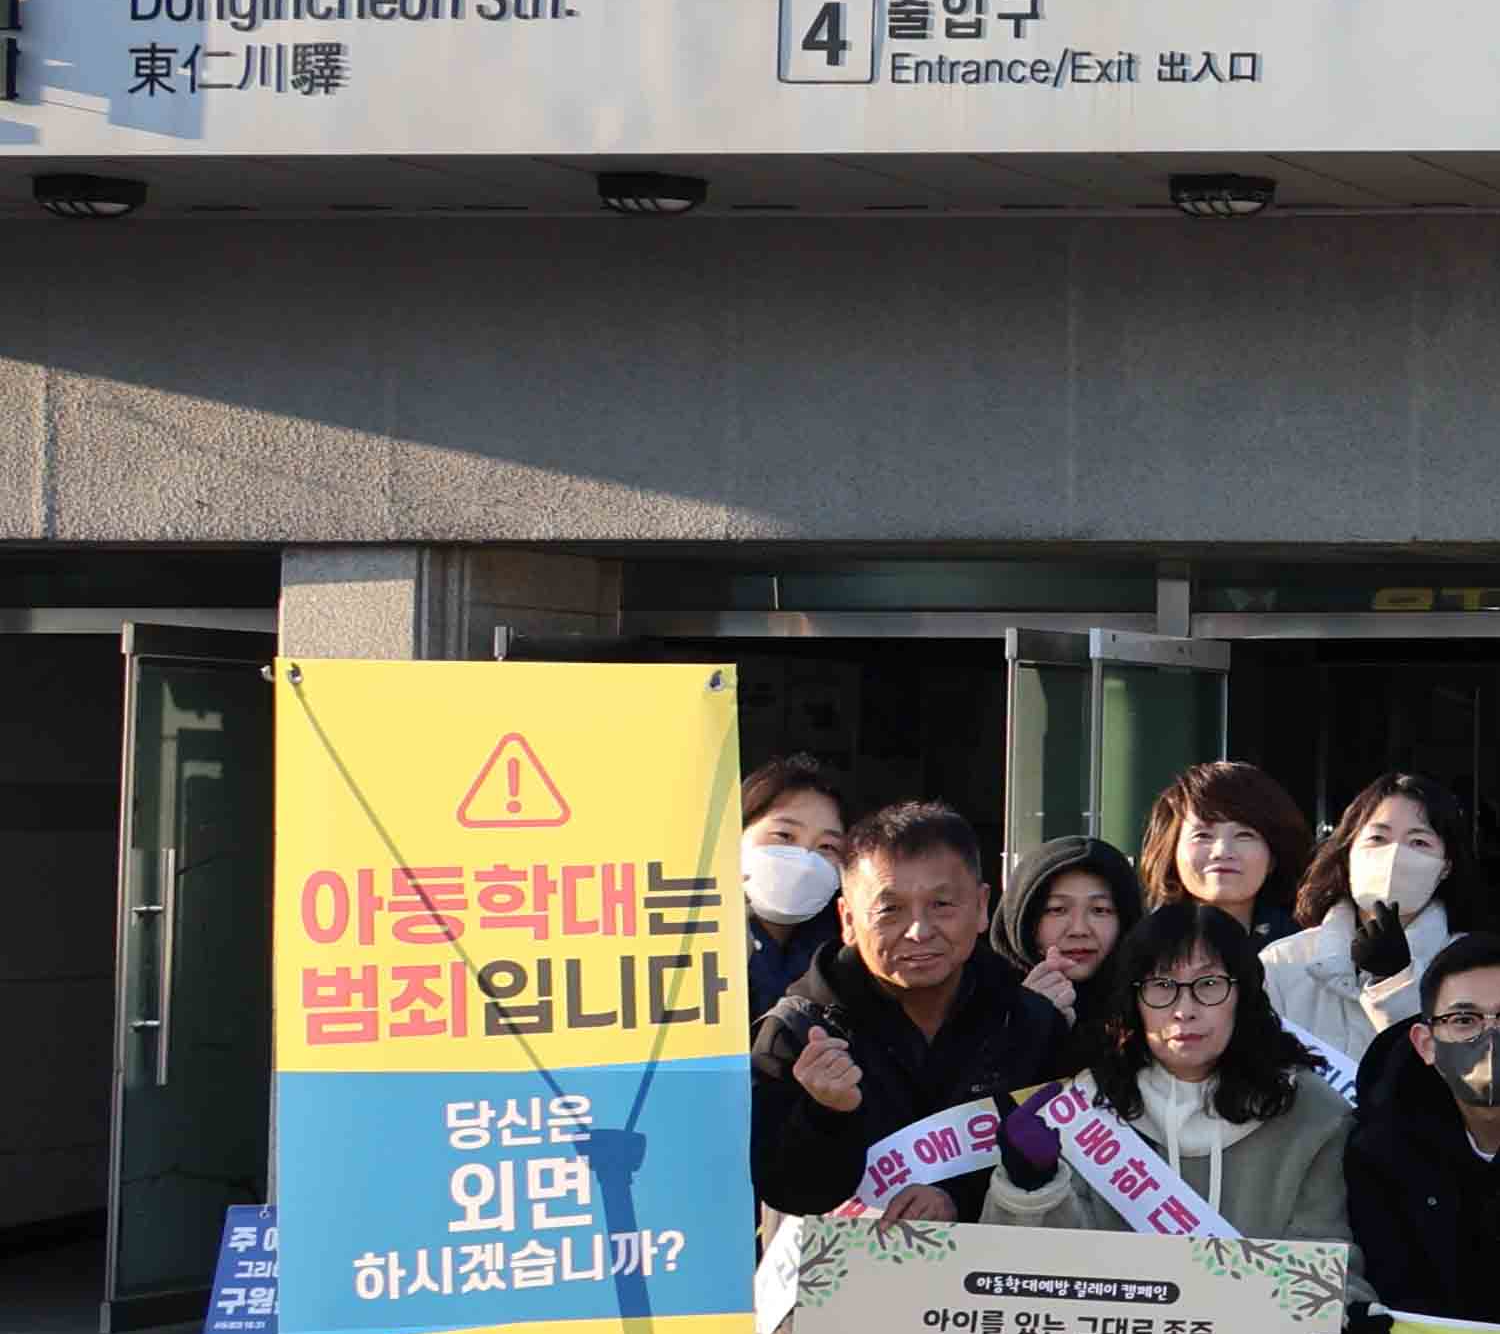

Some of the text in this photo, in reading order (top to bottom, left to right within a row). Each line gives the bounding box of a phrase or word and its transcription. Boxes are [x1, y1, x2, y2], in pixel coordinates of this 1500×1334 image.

[801, 1, 848, 67] 4
[128, 42, 350, 97] 東仁川驛
[891, 47, 1262, 88] Entrance/Exit 出入口
[300, 860, 722, 947] 아동학대는
[302, 951, 728, 1046] 범죄입니다
[446, 1093, 593, 1151] 당신은
[449, 1155, 593, 1233] 외면
[234, 1260, 279, 1279] 그리
[353, 1229, 686, 1301] 하시겠습니까?
[976, 1273, 1169, 1302] 아동학대예방 릴레이 캠페인
